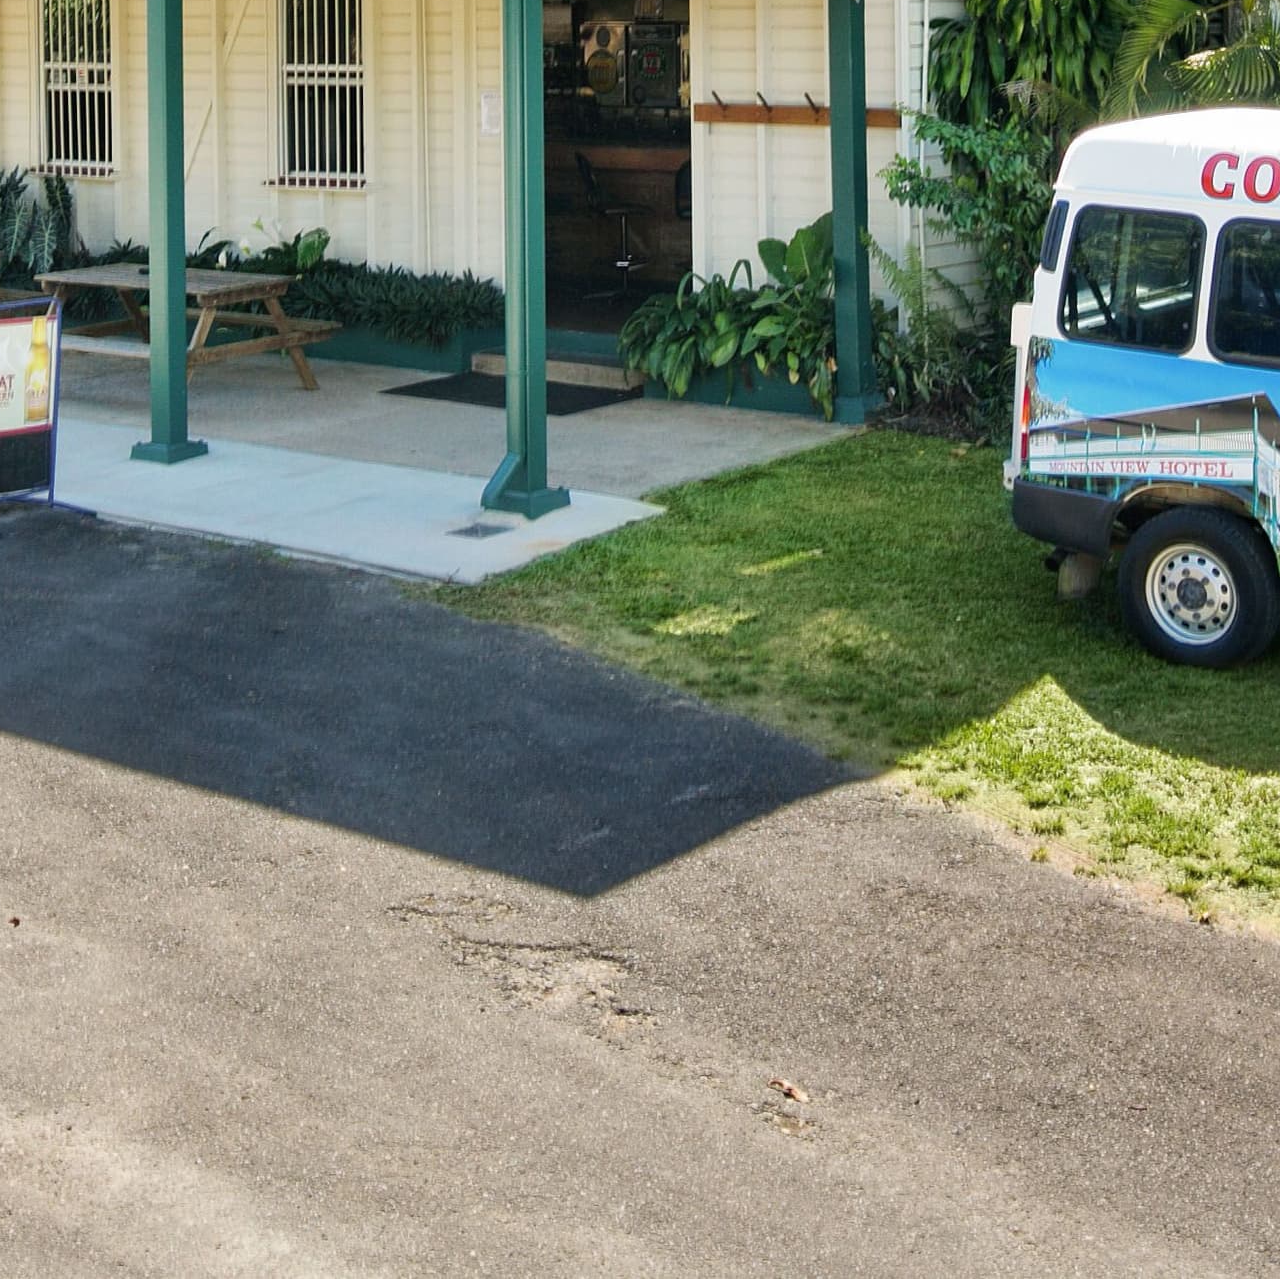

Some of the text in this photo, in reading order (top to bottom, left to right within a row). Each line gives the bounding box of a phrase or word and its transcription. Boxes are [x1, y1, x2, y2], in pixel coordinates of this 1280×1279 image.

[1048, 460, 1234, 478] MOUNTAIN VIEW HOTEL
